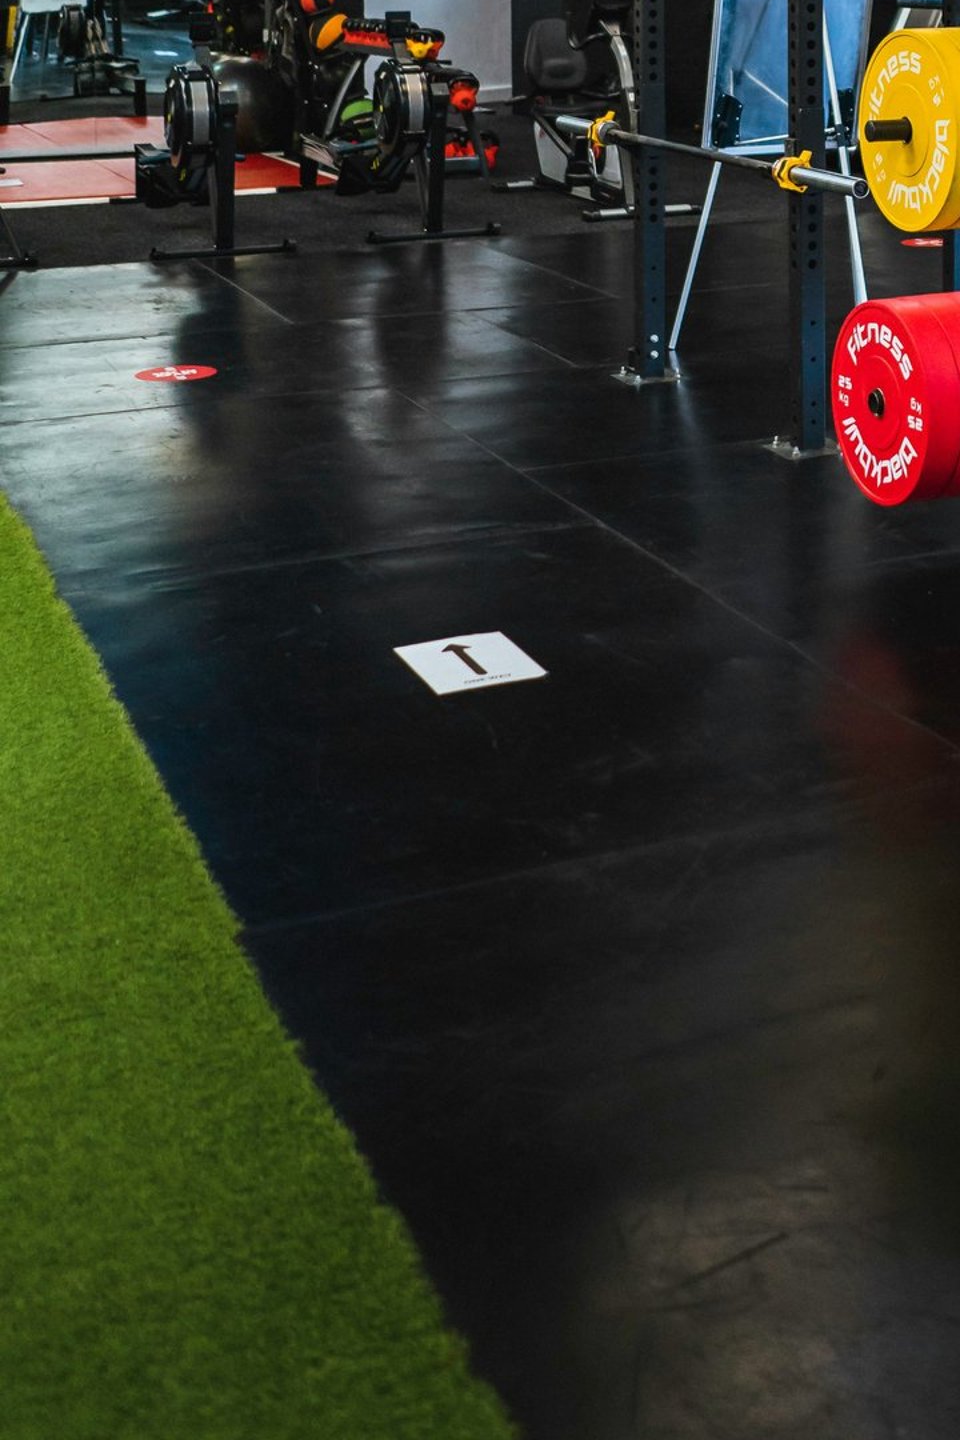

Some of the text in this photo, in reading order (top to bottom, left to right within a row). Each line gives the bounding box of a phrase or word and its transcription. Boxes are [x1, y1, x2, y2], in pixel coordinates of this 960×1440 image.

[847, 322, 914, 381] Fitness
[838, 375, 852, 391] 25
[838, 391, 850, 406] kg
[910, 397, 922, 414] kg
[907, 415, 924, 432] 25
